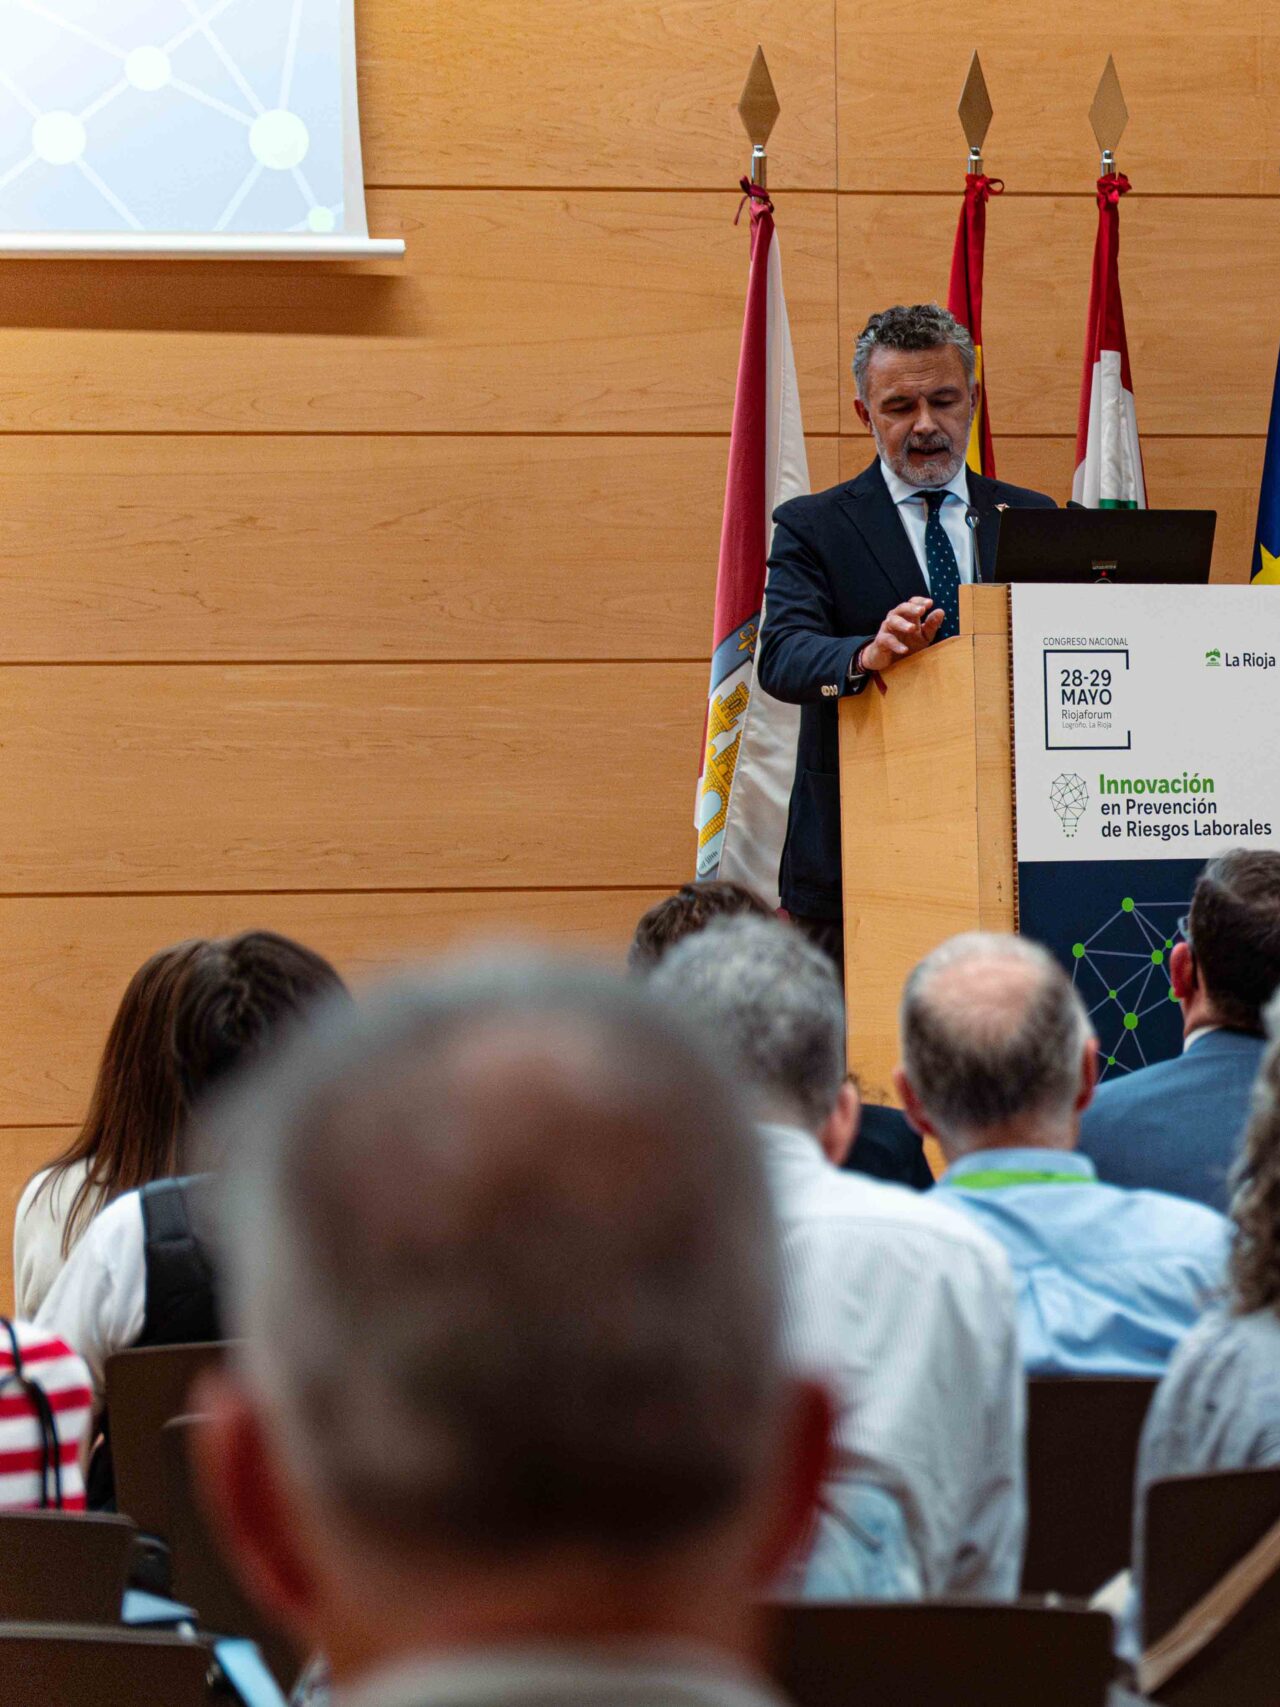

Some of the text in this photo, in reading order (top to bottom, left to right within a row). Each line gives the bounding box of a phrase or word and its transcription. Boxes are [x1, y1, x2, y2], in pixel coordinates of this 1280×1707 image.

[1042, 637, 1129, 646] CONGRESO NACIONAL
[1225, 652, 1276, 670] La Rioja
[1060, 669, 1112, 687] 28-29
[1061, 688, 1112, 706] MAYO
[1061, 709, 1112, 721] Riojaforum
[1099, 772, 1215, 795] Innovación
[1101, 798, 1217, 816] en Prevención
[1101, 819, 1272, 842] de Riesgos Laborales
